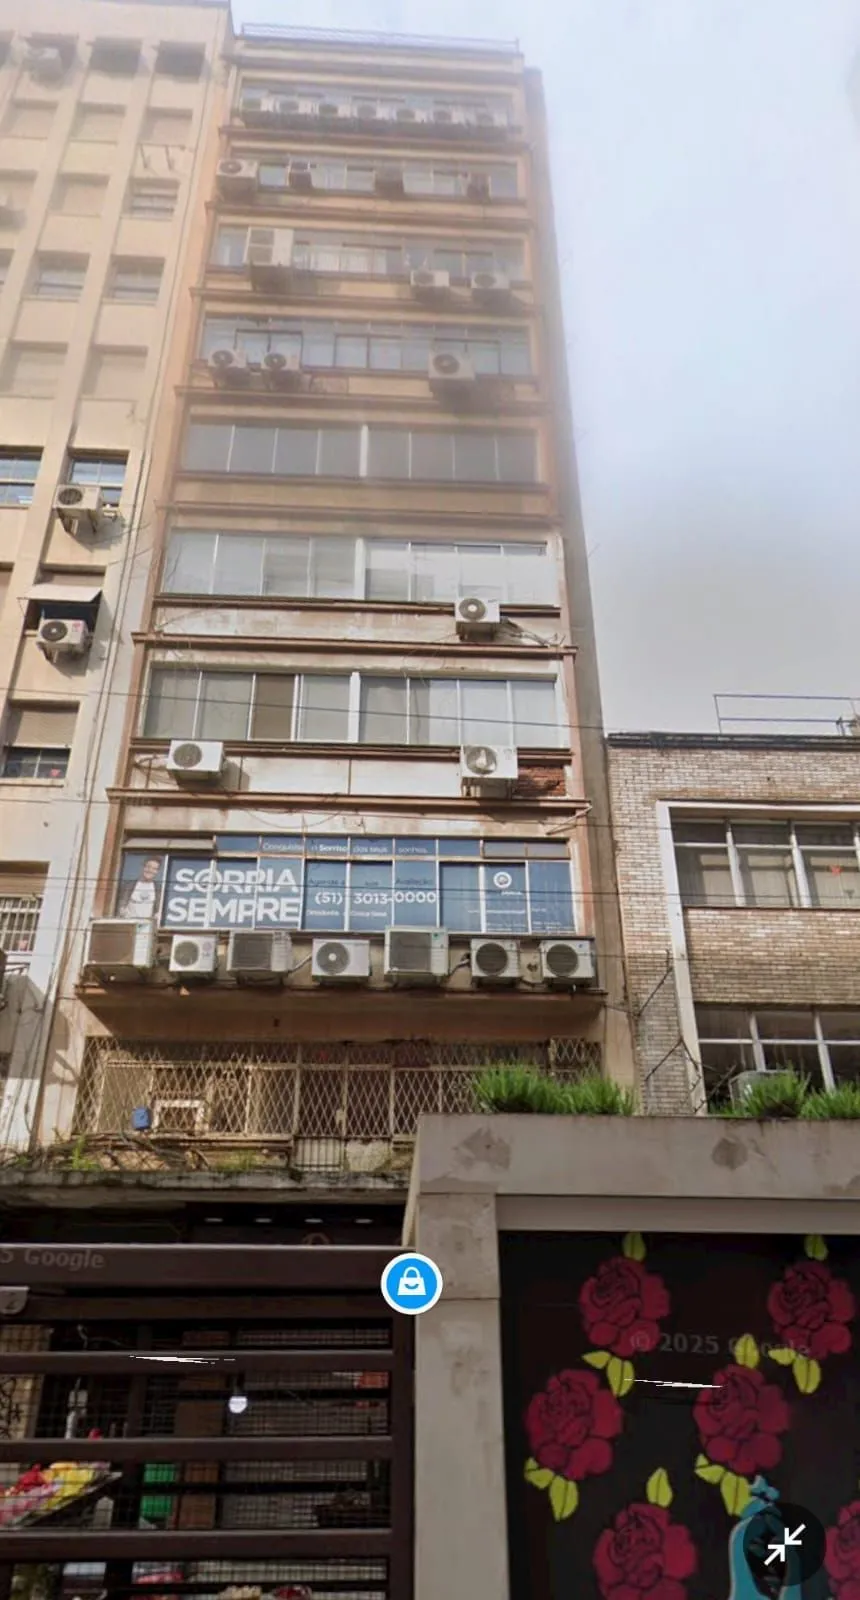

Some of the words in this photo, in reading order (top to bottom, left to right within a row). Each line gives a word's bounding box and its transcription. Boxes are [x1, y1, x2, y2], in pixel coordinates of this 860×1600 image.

[173, 868, 299, 893] SORRIA
[315, 891, 343, 905] (51)
[353, 890, 437, 905] 3013-0000
[166, 897, 301, 924] SEMPRE
